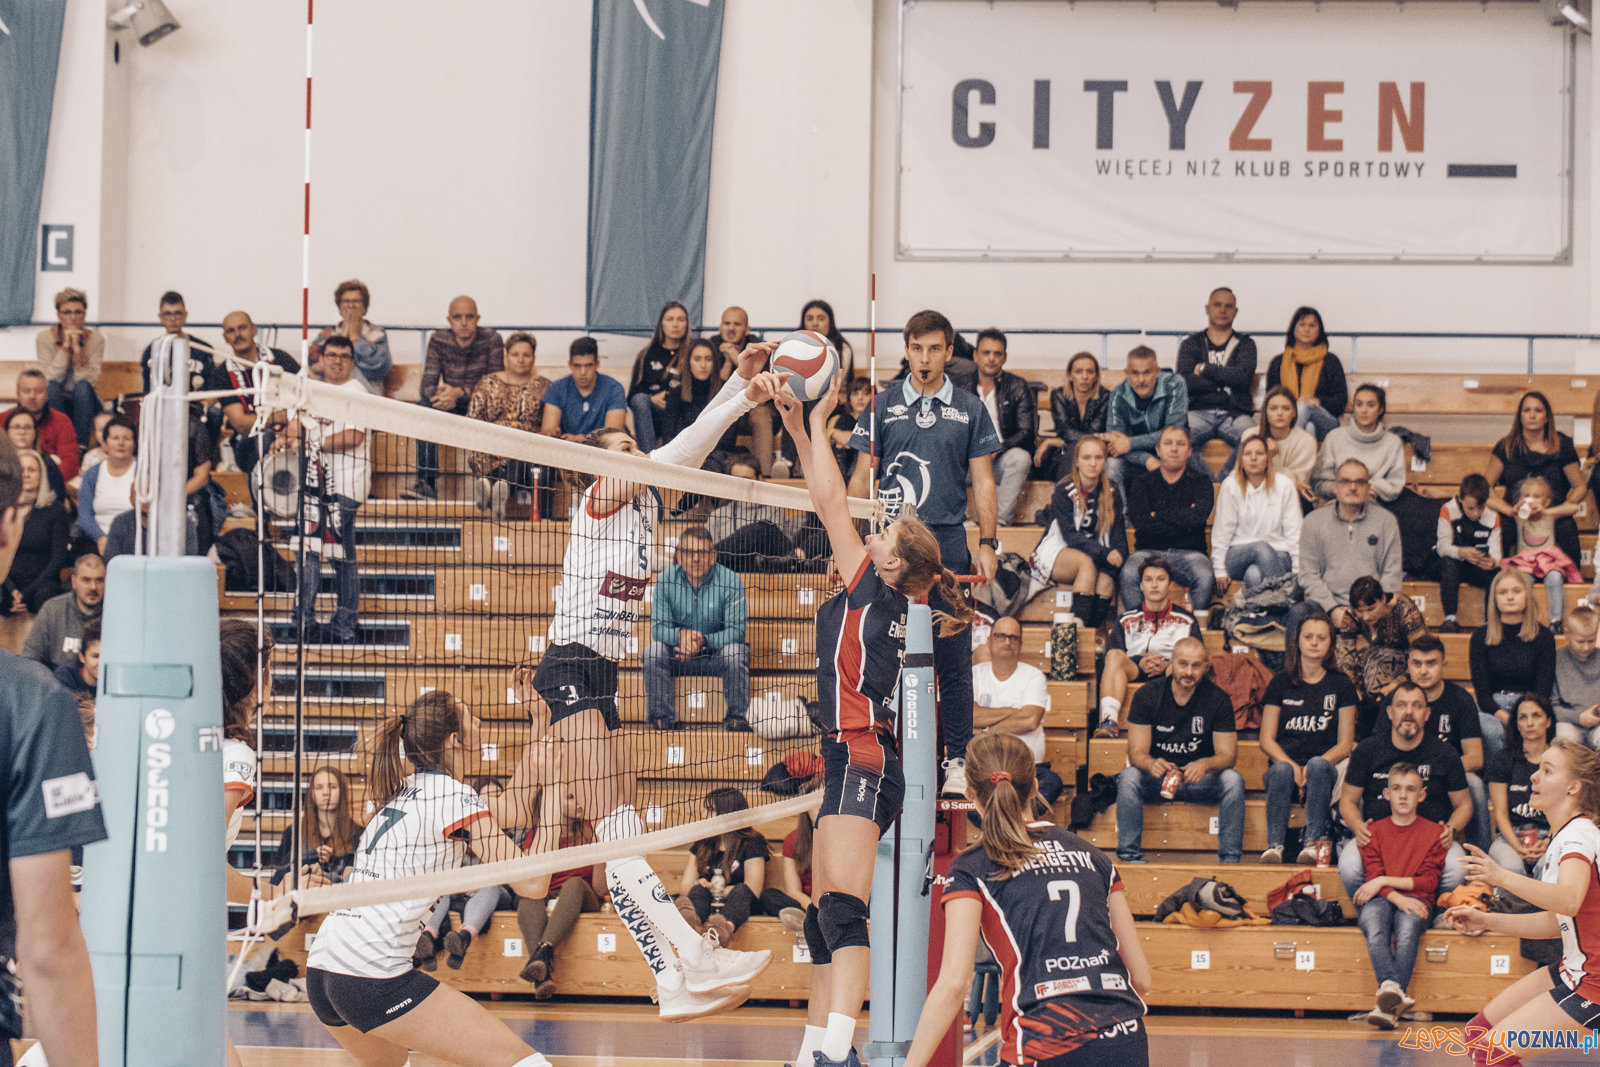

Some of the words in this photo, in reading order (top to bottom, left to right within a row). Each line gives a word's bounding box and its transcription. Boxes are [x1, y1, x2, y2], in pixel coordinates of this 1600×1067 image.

[951, 78, 1426, 153] CITYZEN
[1096, 159, 1173, 179] WIĘCEJ
[1186, 158, 1221, 177] NIŻ
[1234, 161, 1290, 177] KLUB
[1304, 161, 1425, 178] SPORTOWY
[48, 231, 68, 265] C
[906, 689, 918, 739] Senoh
[145, 743, 172, 853] Senoh
[951, 801, 977, 810] Seno
[365, 807, 408, 855] 7
[1033, 840, 1065, 853] NEA
[1047, 880, 1081, 943] 7
[1196, 954, 1206, 963] 15
[1300, 954, 1310, 963] 14
[1495, 958, 1505, 968] 12
